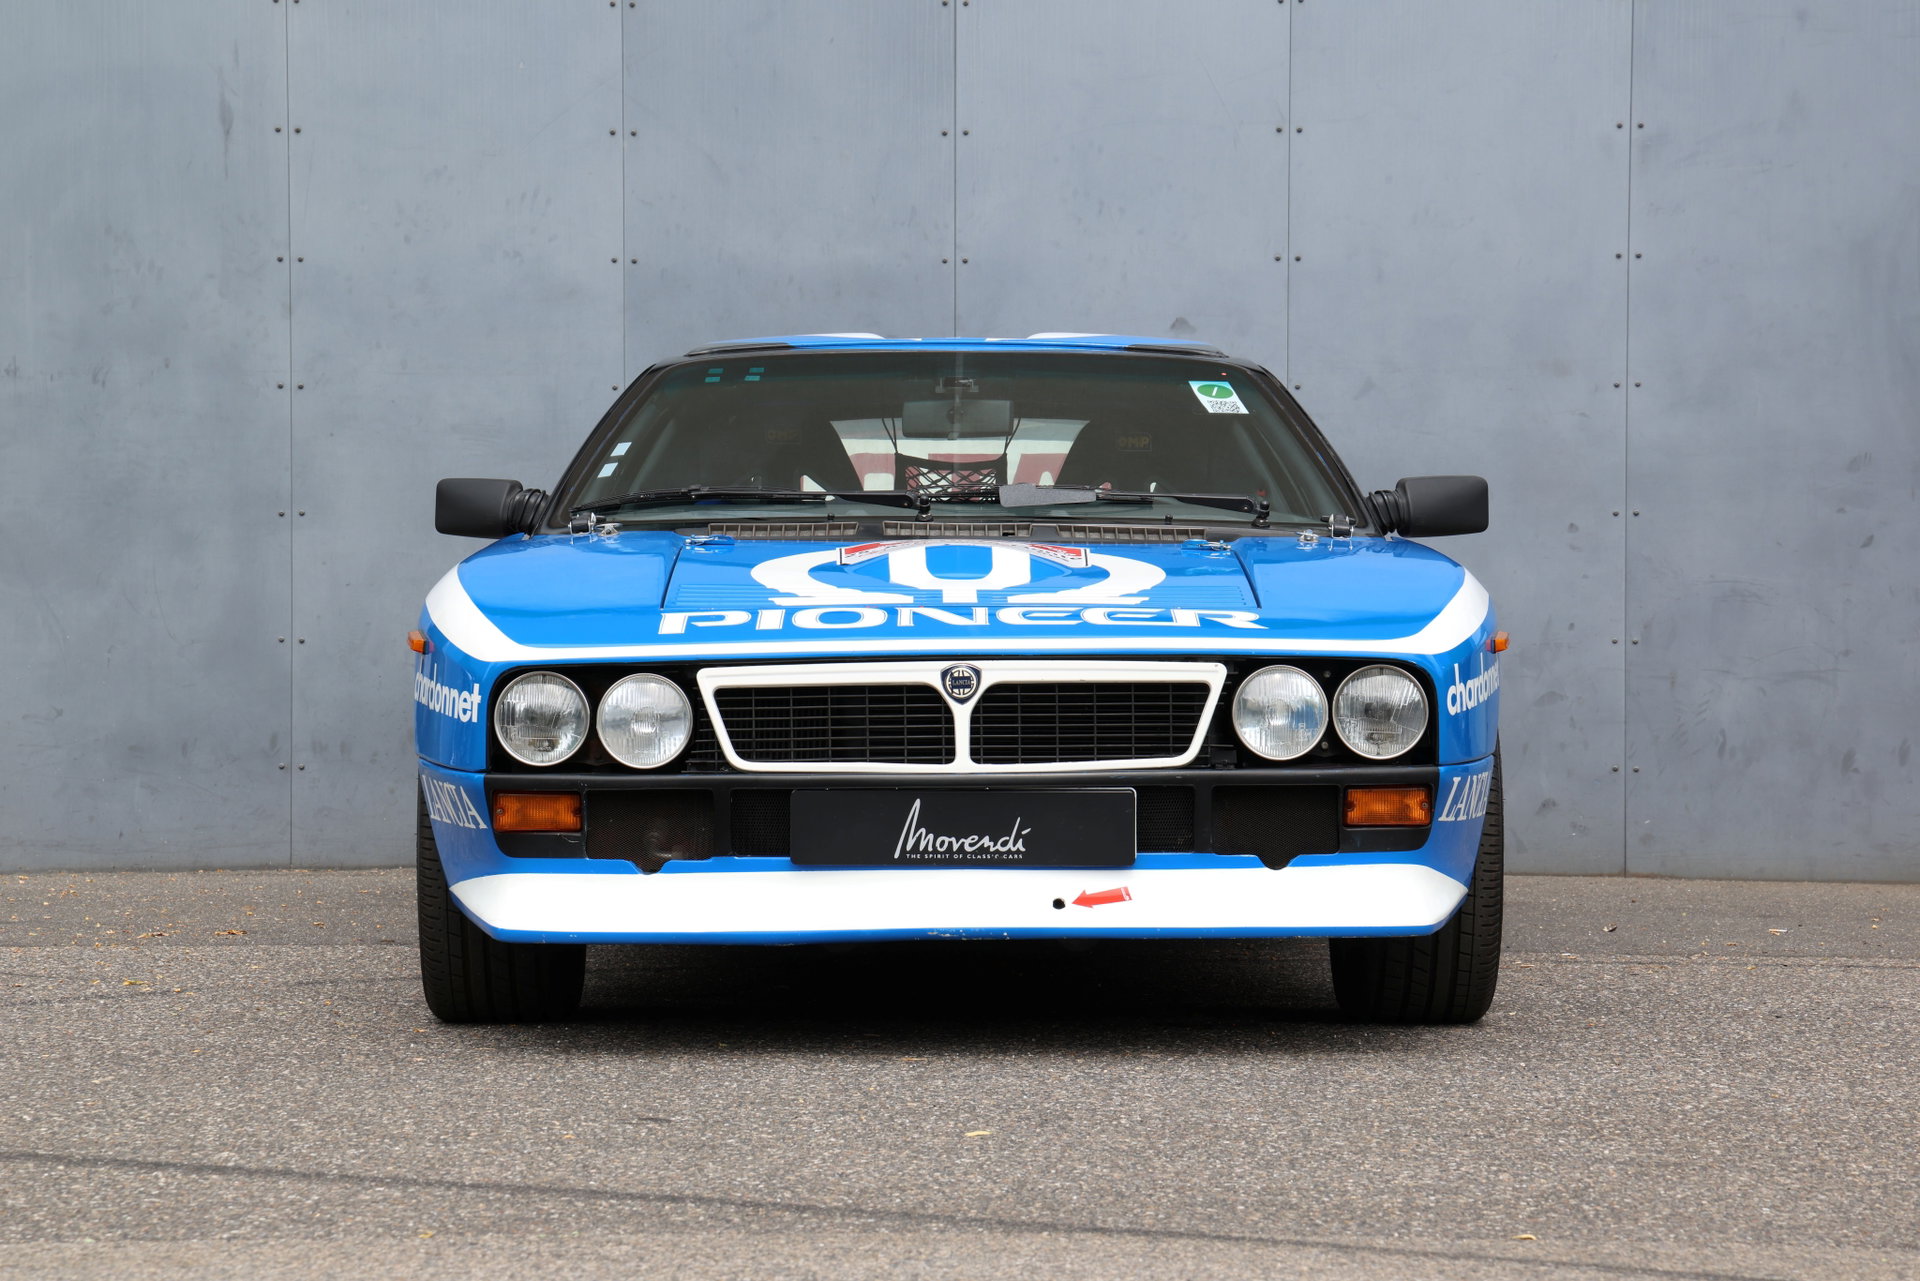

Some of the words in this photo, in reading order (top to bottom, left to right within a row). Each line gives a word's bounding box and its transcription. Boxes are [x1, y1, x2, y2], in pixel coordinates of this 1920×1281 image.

[657, 607, 1269, 635] PIONEER
[414, 655, 482, 723] chardonnet
[421, 774, 488, 829] LANCIA
